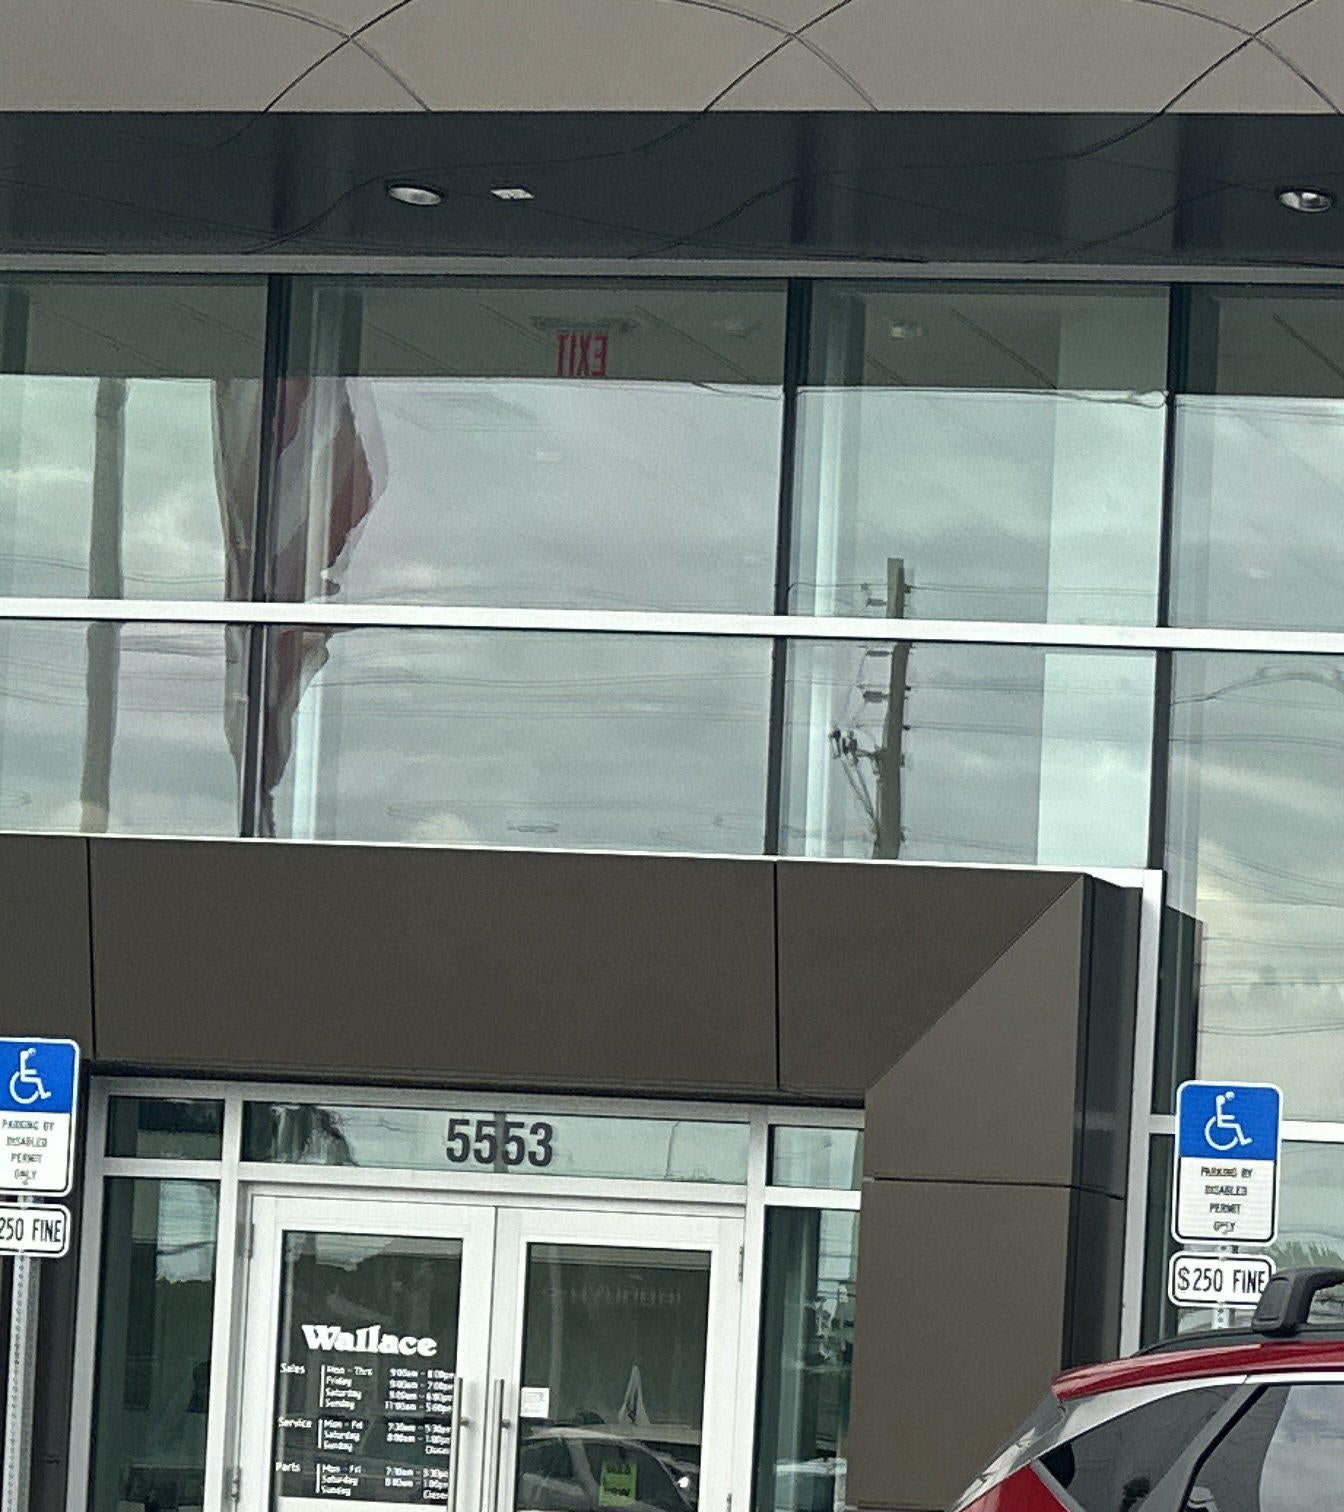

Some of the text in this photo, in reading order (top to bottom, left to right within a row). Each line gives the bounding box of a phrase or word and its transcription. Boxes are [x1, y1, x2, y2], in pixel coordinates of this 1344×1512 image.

[446, 1118, 553, 1167] 5553
[32, 1219, 62, 1242] FINE
[1177, 1266, 1266, 1294] $250 FINE
[301, 1324, 438, 1357] Wallace
